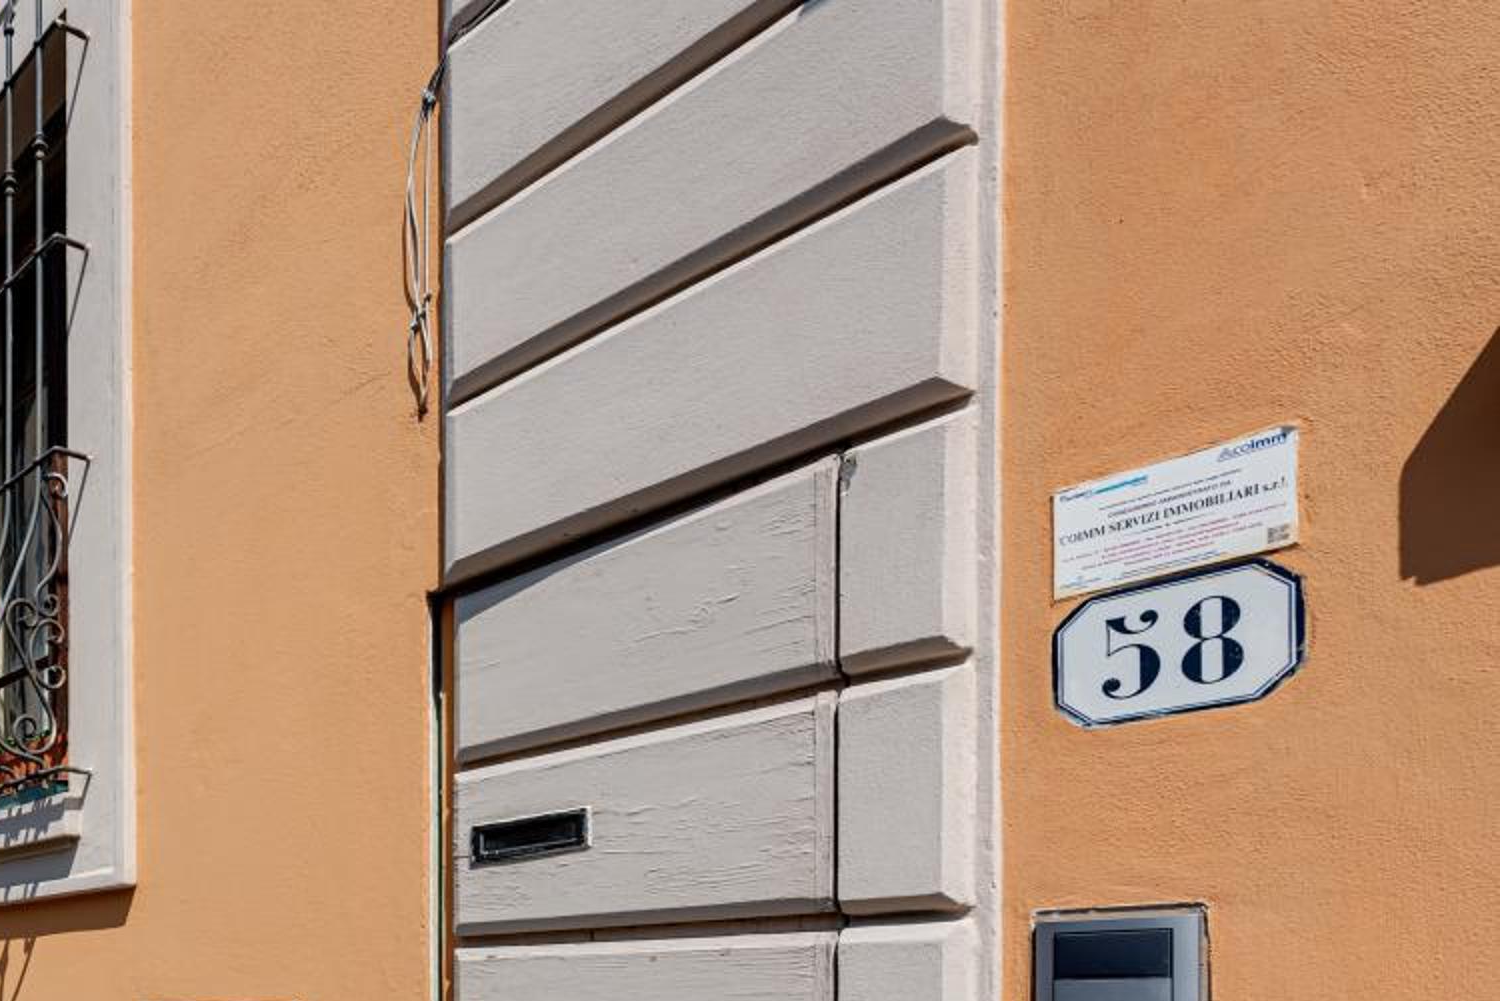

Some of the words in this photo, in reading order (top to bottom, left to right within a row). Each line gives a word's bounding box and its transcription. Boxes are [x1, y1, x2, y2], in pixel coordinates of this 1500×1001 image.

[1059, 521, 1106, 547] COIMM
[1108, 507, 1161, 533] SERVIZI
[1163, 482, 1260, 520] IMMOBILIARI
[1102, 595, 1244, 701] 58
